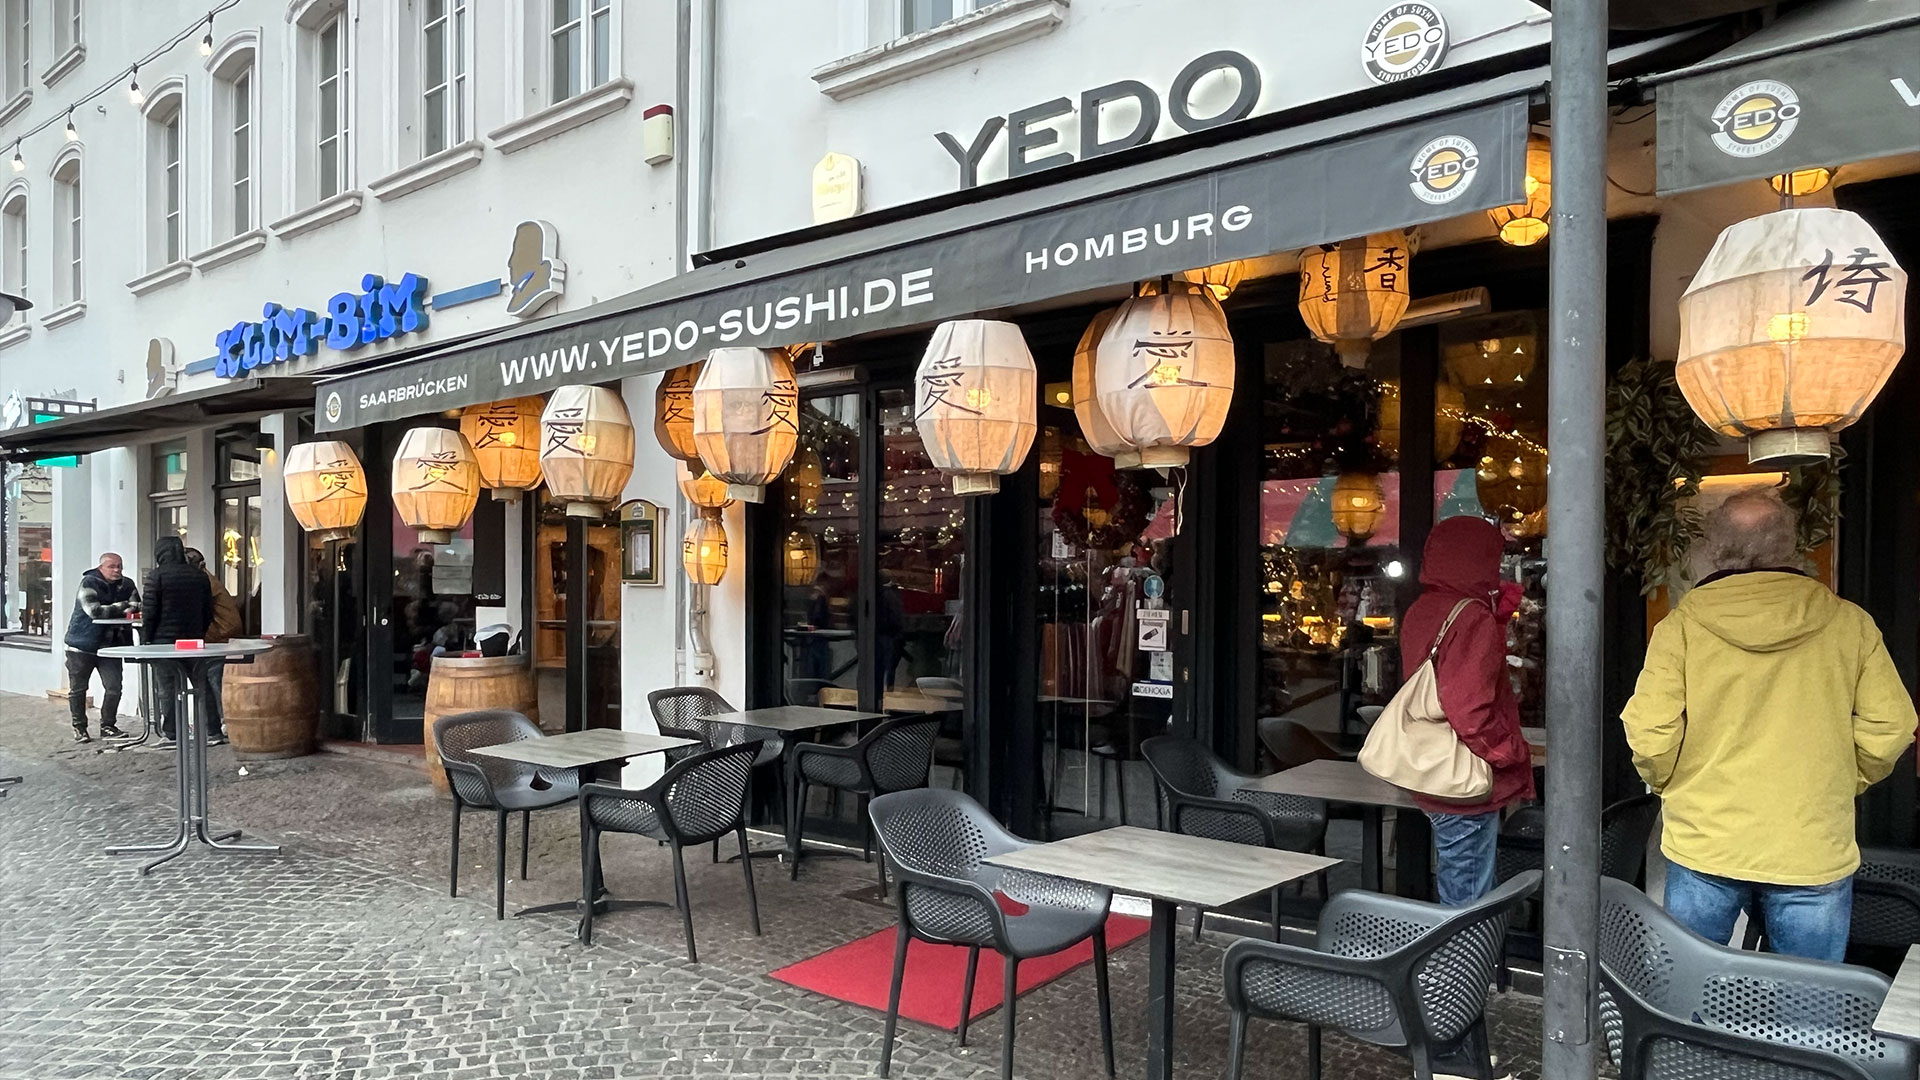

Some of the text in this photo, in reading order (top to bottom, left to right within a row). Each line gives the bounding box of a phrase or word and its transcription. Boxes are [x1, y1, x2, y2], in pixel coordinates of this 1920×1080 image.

[1372, 5, 1435, 36] HOME OF SUSHI
[1365, 27, 1443, 58] YEDO
[1377, 59, 1429, 82] STREET FOOD
[1722, 84, 1790, 112] HOME OF SUSHI
[934, 50, 1262, 188] YEDO
[1711, 104, 1800, 132] YEDO
[1417, 145, 1436, 163] HOME
[1452, 139, 1471, 153] SUSHI
[1727, 134, 1783, 154] STREET FOOD
[1410, 156, 1479, 182] YEDO
[1423, 182, 1466, 200] STREET FOOD
[1026, 205, 1253, 274] HOMBURG
[1363, 246, 1405, 292] 香
[1801, 247, 1893, 314] 侍
[500, 267, 935, 387] WWW.YEDO-SUSHI.DE
[359, 374, 467, 409] SAARBRÜCKEN
